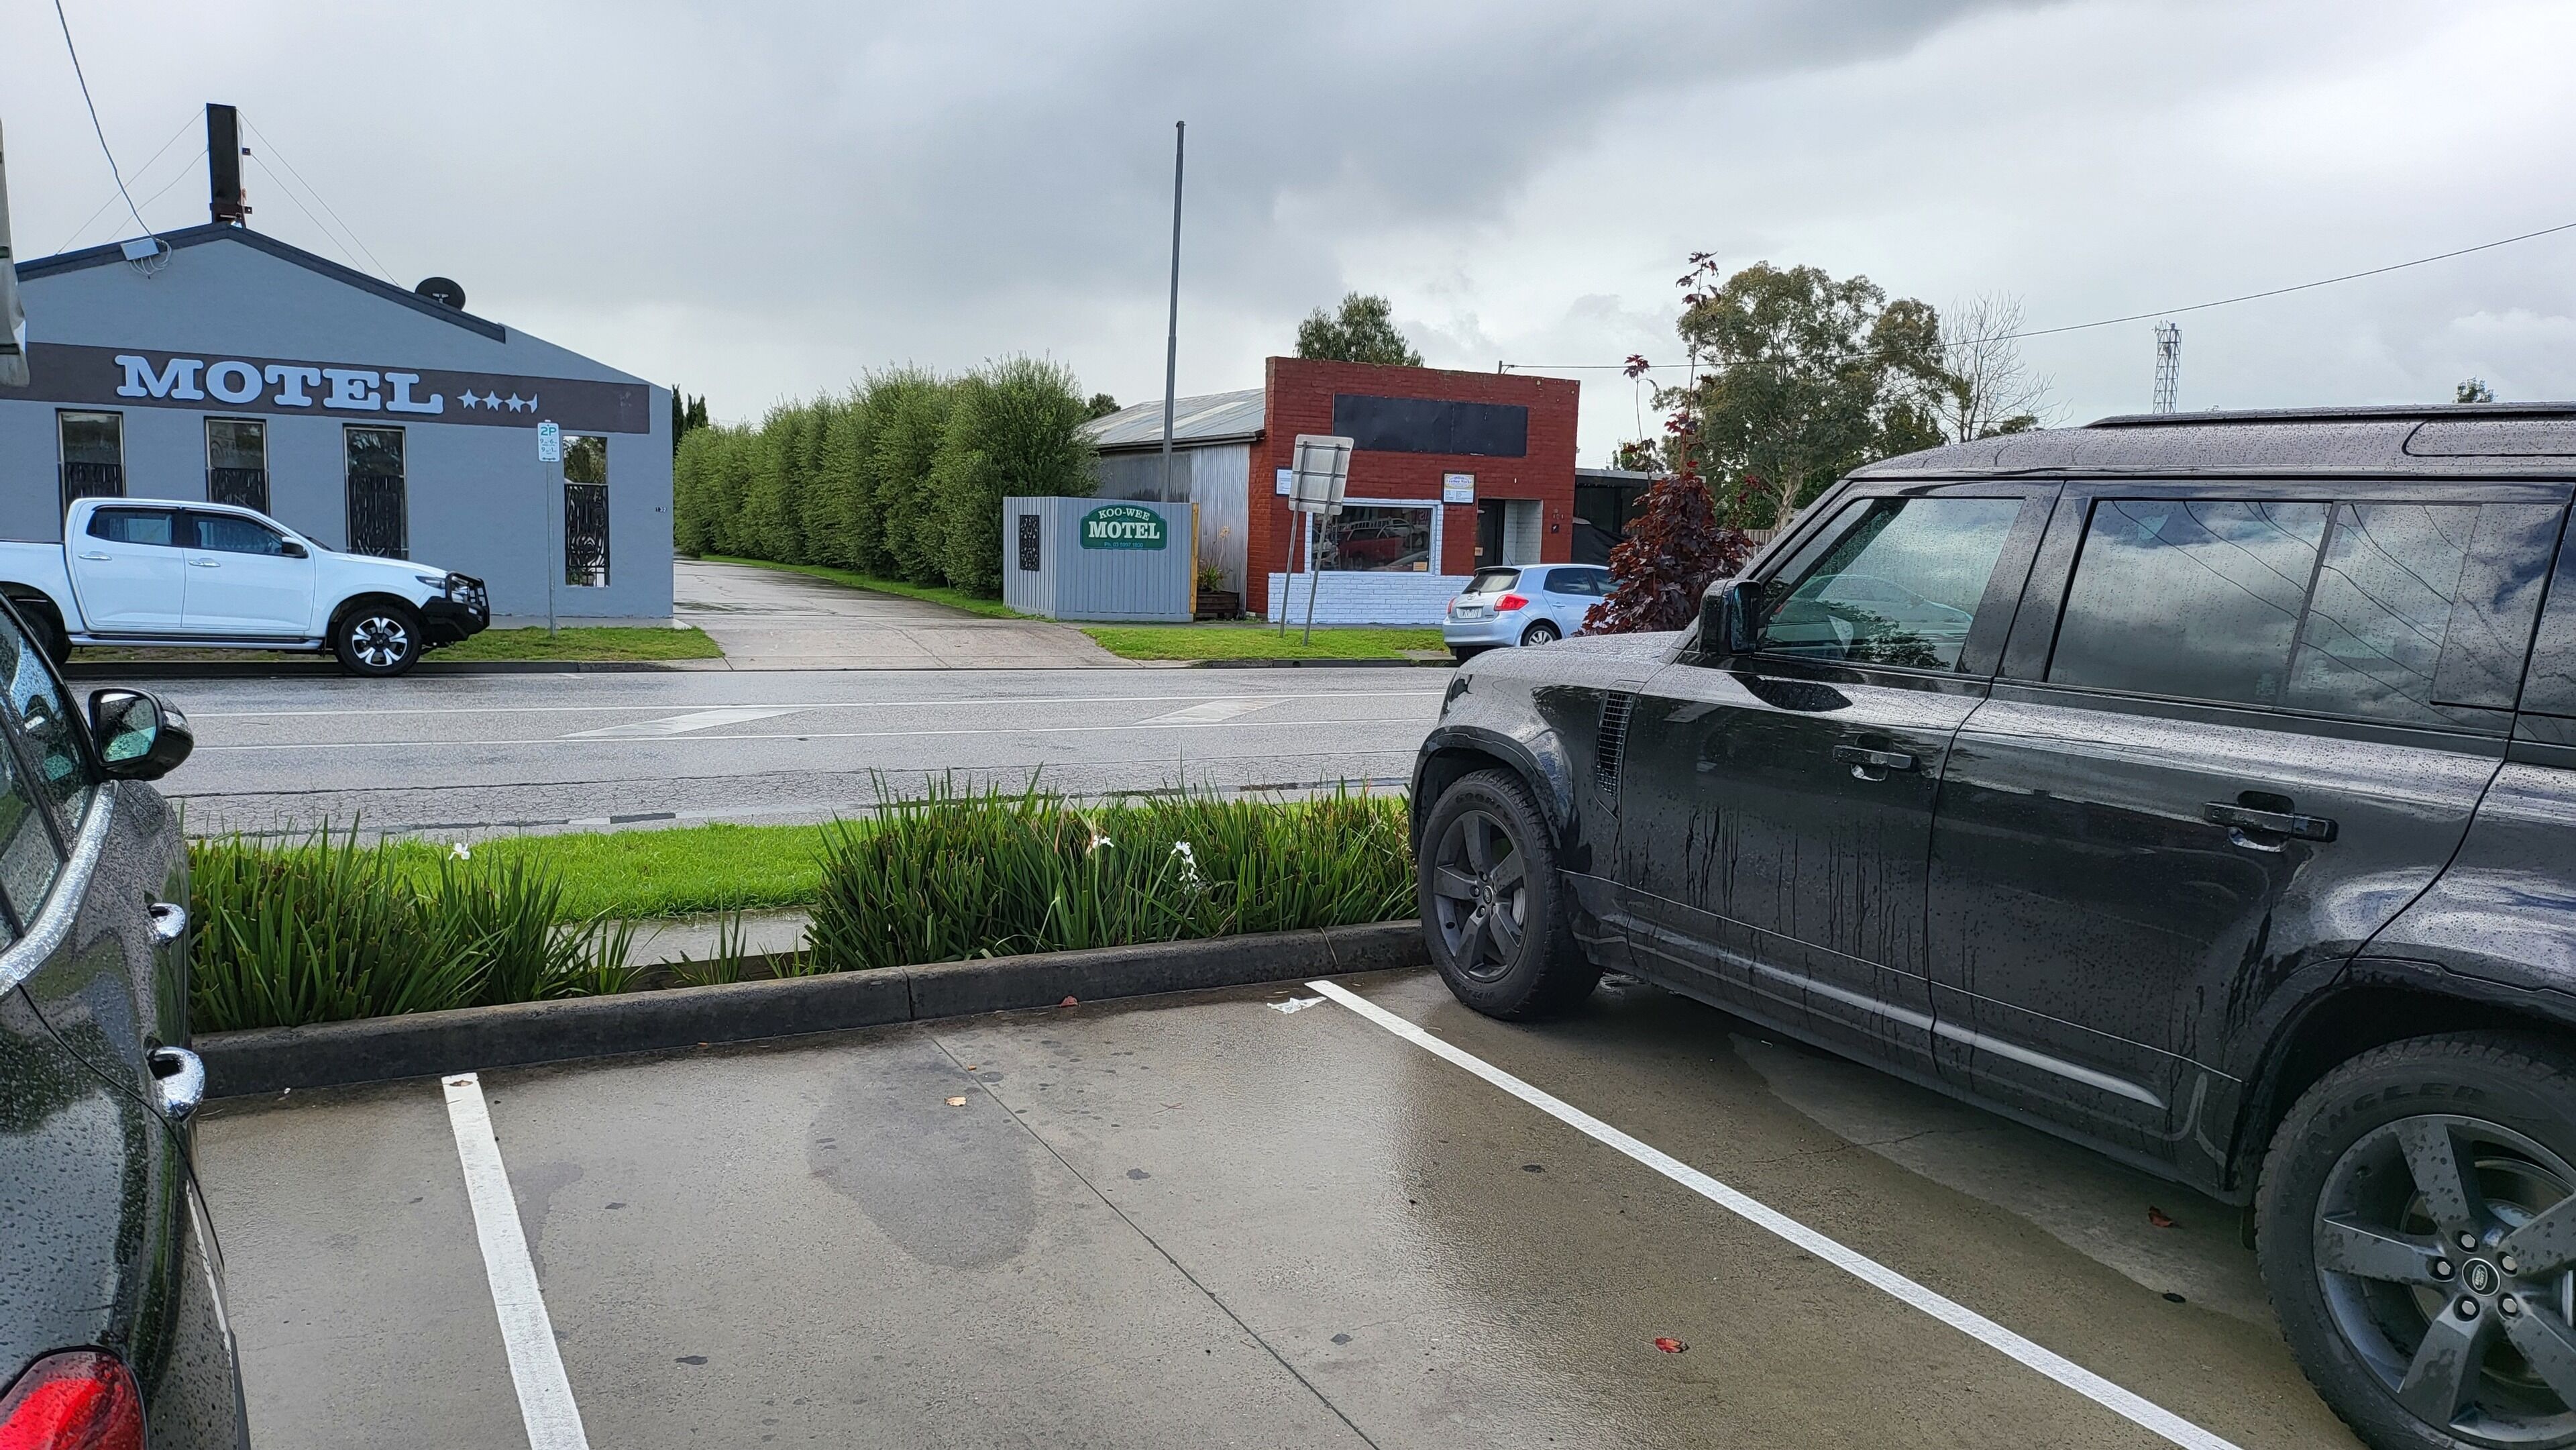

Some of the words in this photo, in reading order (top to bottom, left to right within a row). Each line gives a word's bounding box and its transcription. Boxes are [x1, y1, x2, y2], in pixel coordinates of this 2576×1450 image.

[115, 354, 444, 414] MOTEL
[540, 426, 557, 436] 2P
[1098, 507, 1150, 521] KOO-WEE
[1088, 521, 1161, 539] MOTEL
